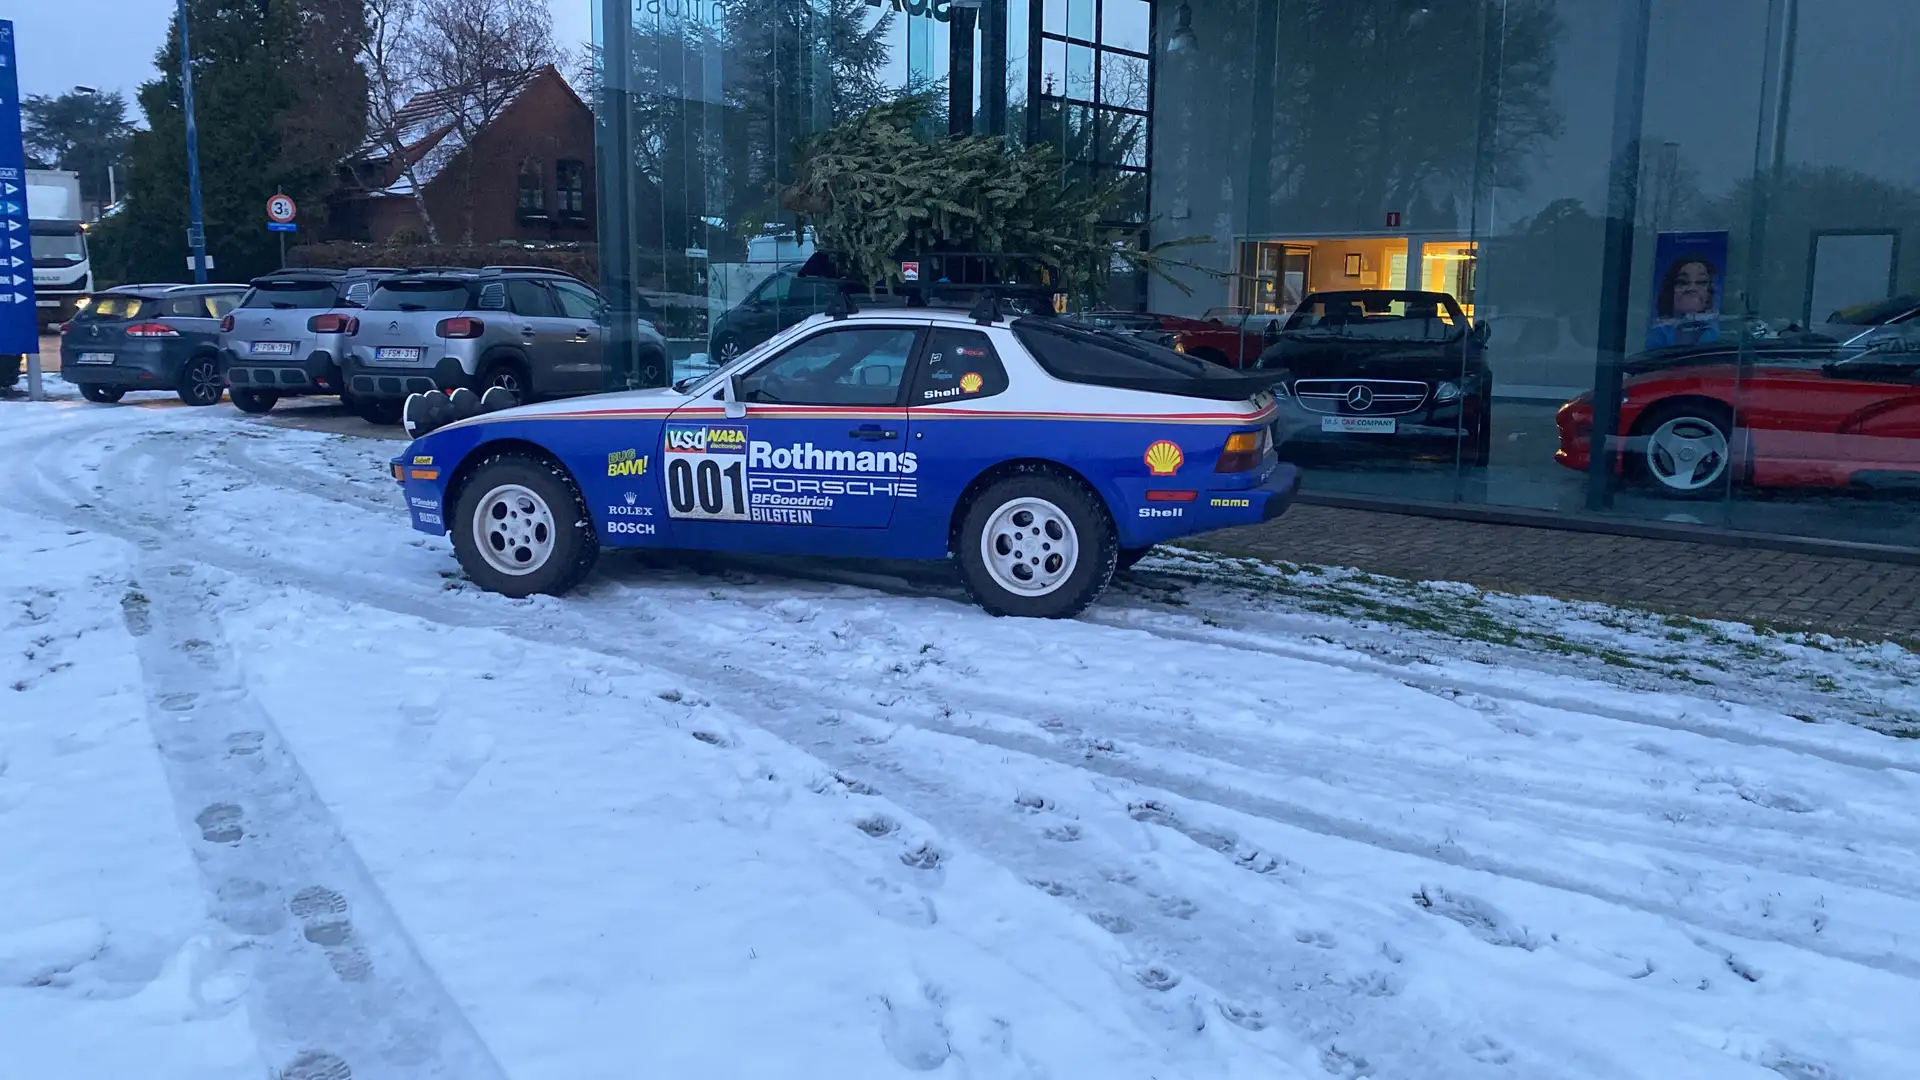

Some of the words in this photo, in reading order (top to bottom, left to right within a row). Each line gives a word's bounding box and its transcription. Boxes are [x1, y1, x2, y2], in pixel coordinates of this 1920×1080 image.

[924, 387, 960, 399] Shell
[1356, 419, 1394, 427] COMPANY
[668, 427, 706, 449] vsd
[608, 448, 636, 464] BUG
[748, 440, 918, 474] Rothmans
[607, 455, 649, 477] BAM!
[668, 458, 746, 515] 001
[748, 477, 918, 498] PORSCHE
[751, 493, 834, 507] BFGoodrich
[1210, 498, 1250, 507] momo
[608, 505, 654, 516] ROLEX
[751, 508, 813, 524] BILSTEIN
[1138, 507, 1183, 518] Shell
[607, 521, 656, 534] BOSCH
